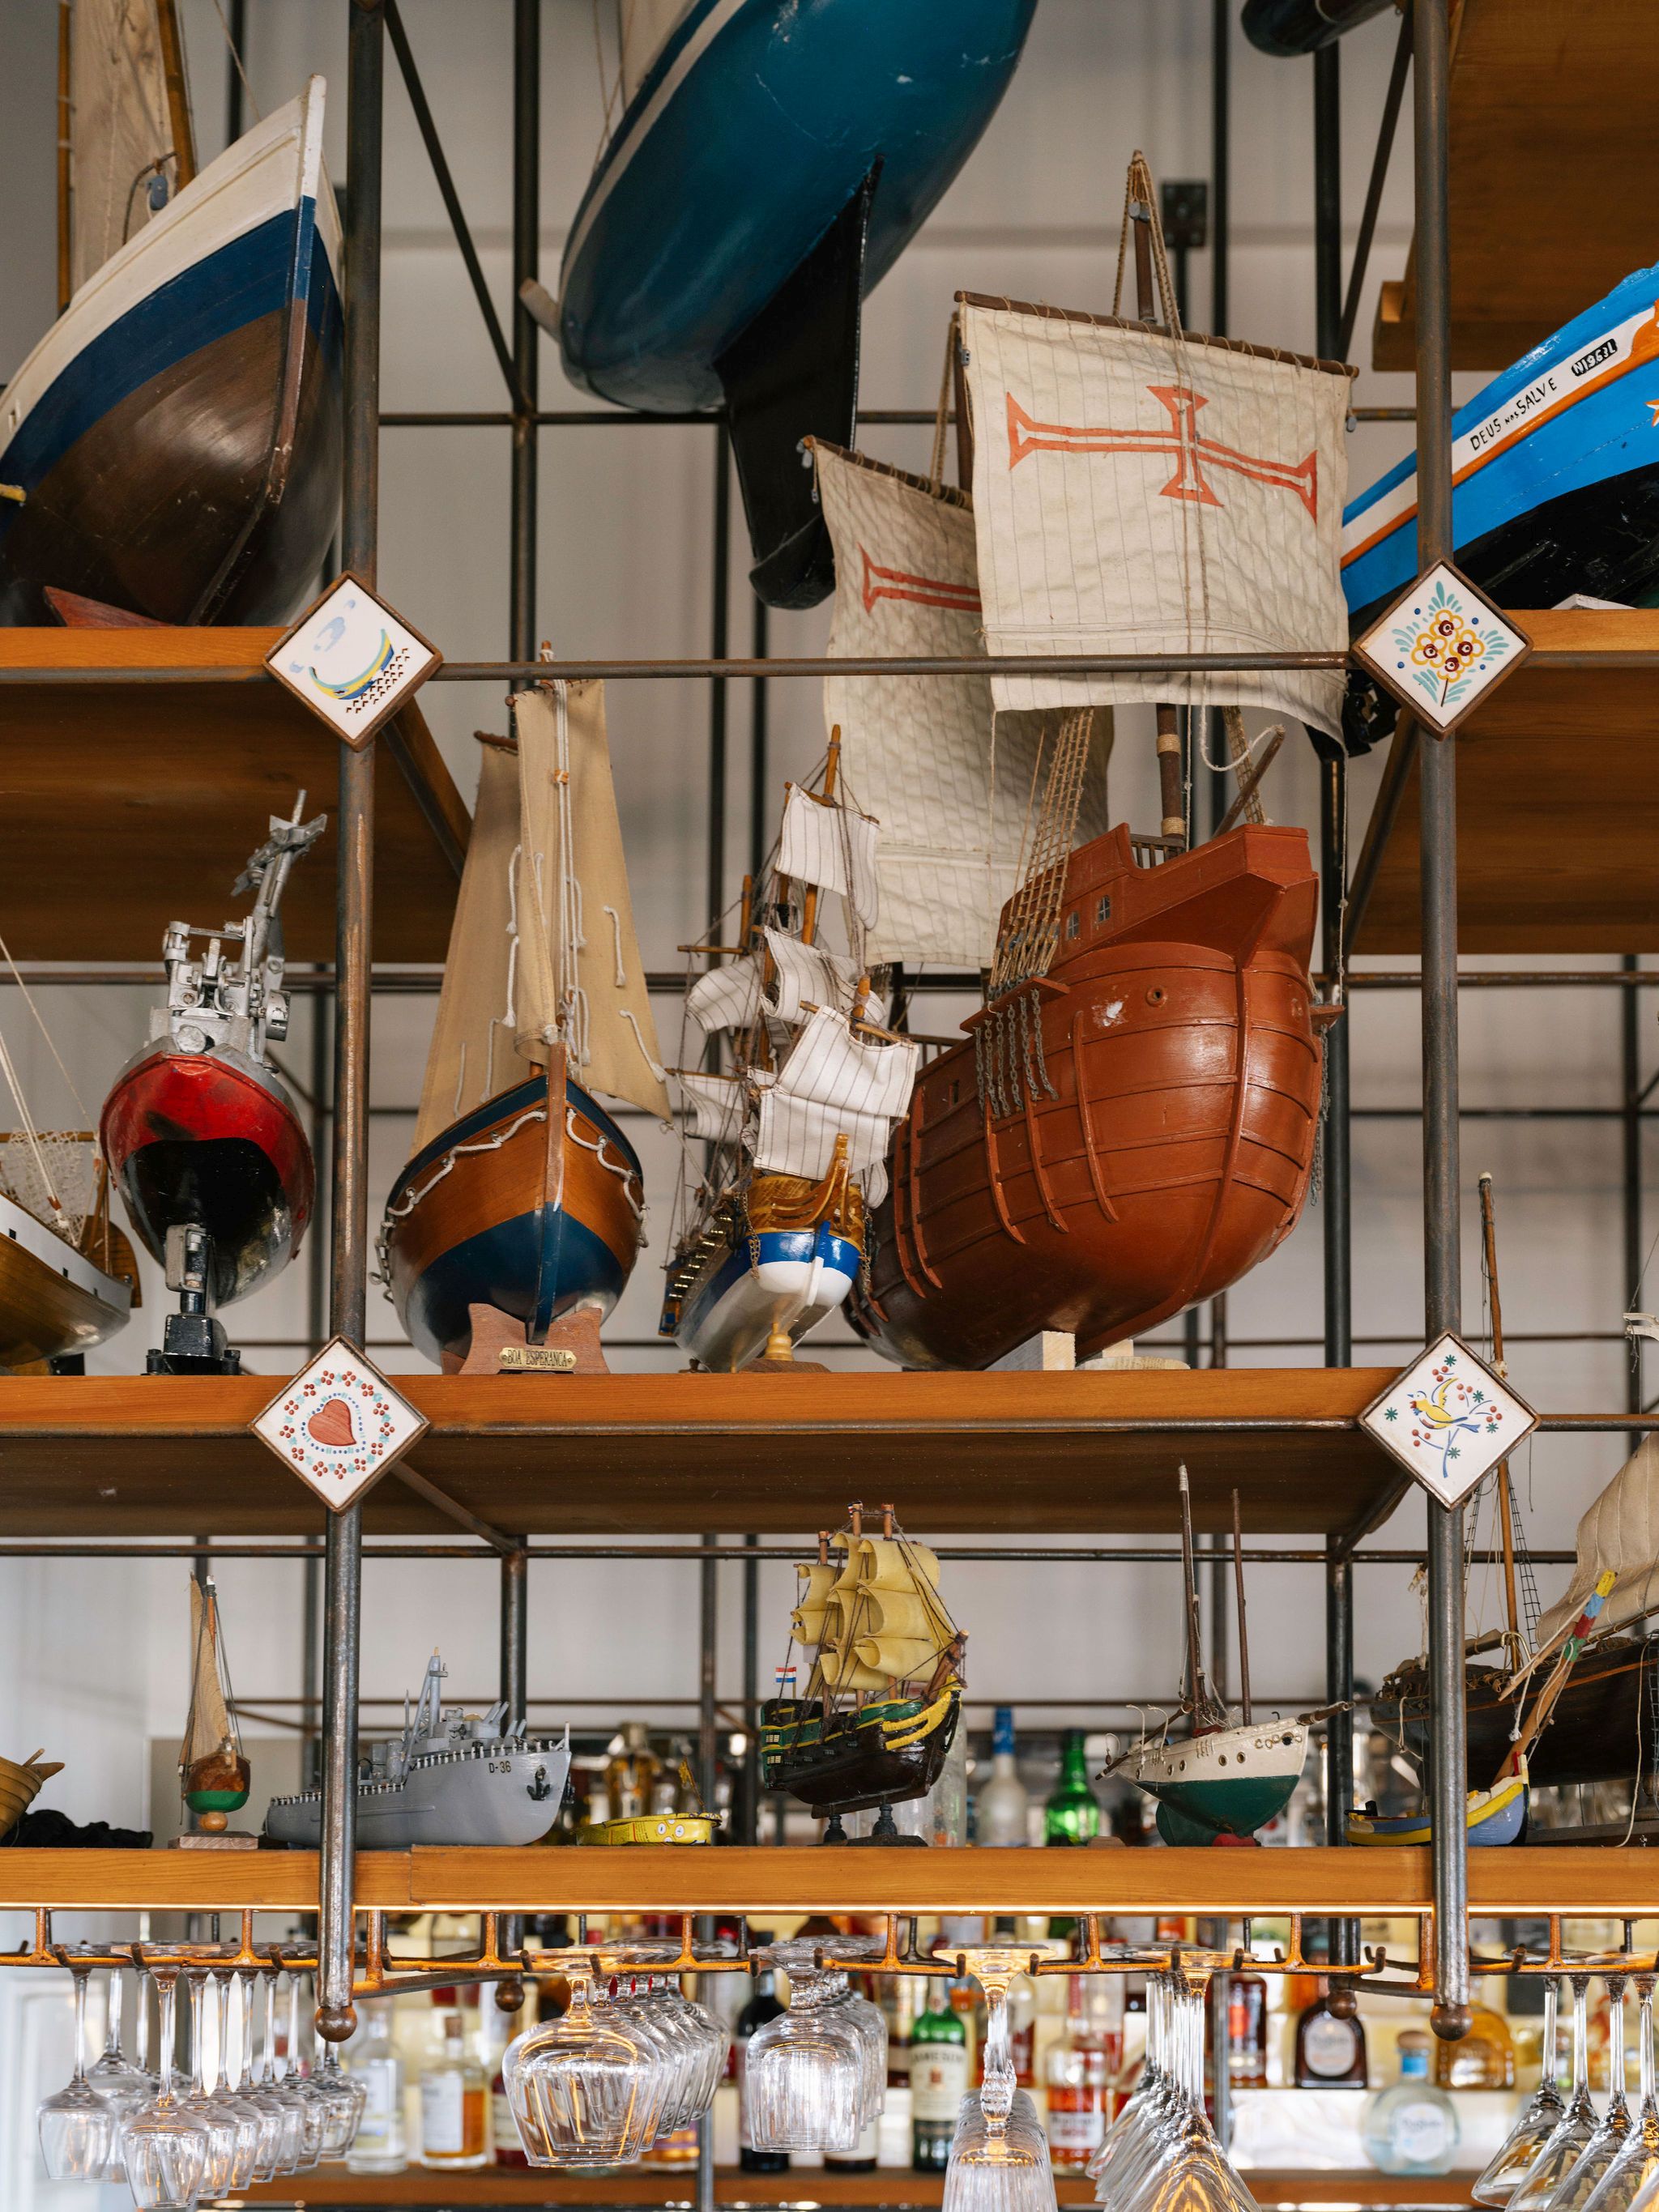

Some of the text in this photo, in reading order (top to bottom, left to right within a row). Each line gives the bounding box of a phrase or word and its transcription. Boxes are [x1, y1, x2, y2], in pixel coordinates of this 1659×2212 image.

[1469, 418, 1502, 451] DEUS
[1516, 377, 1558, 415] SALVE
[507, 1349, 522, 1365] BOA
[488, 1760, 512, 1774] D-36
